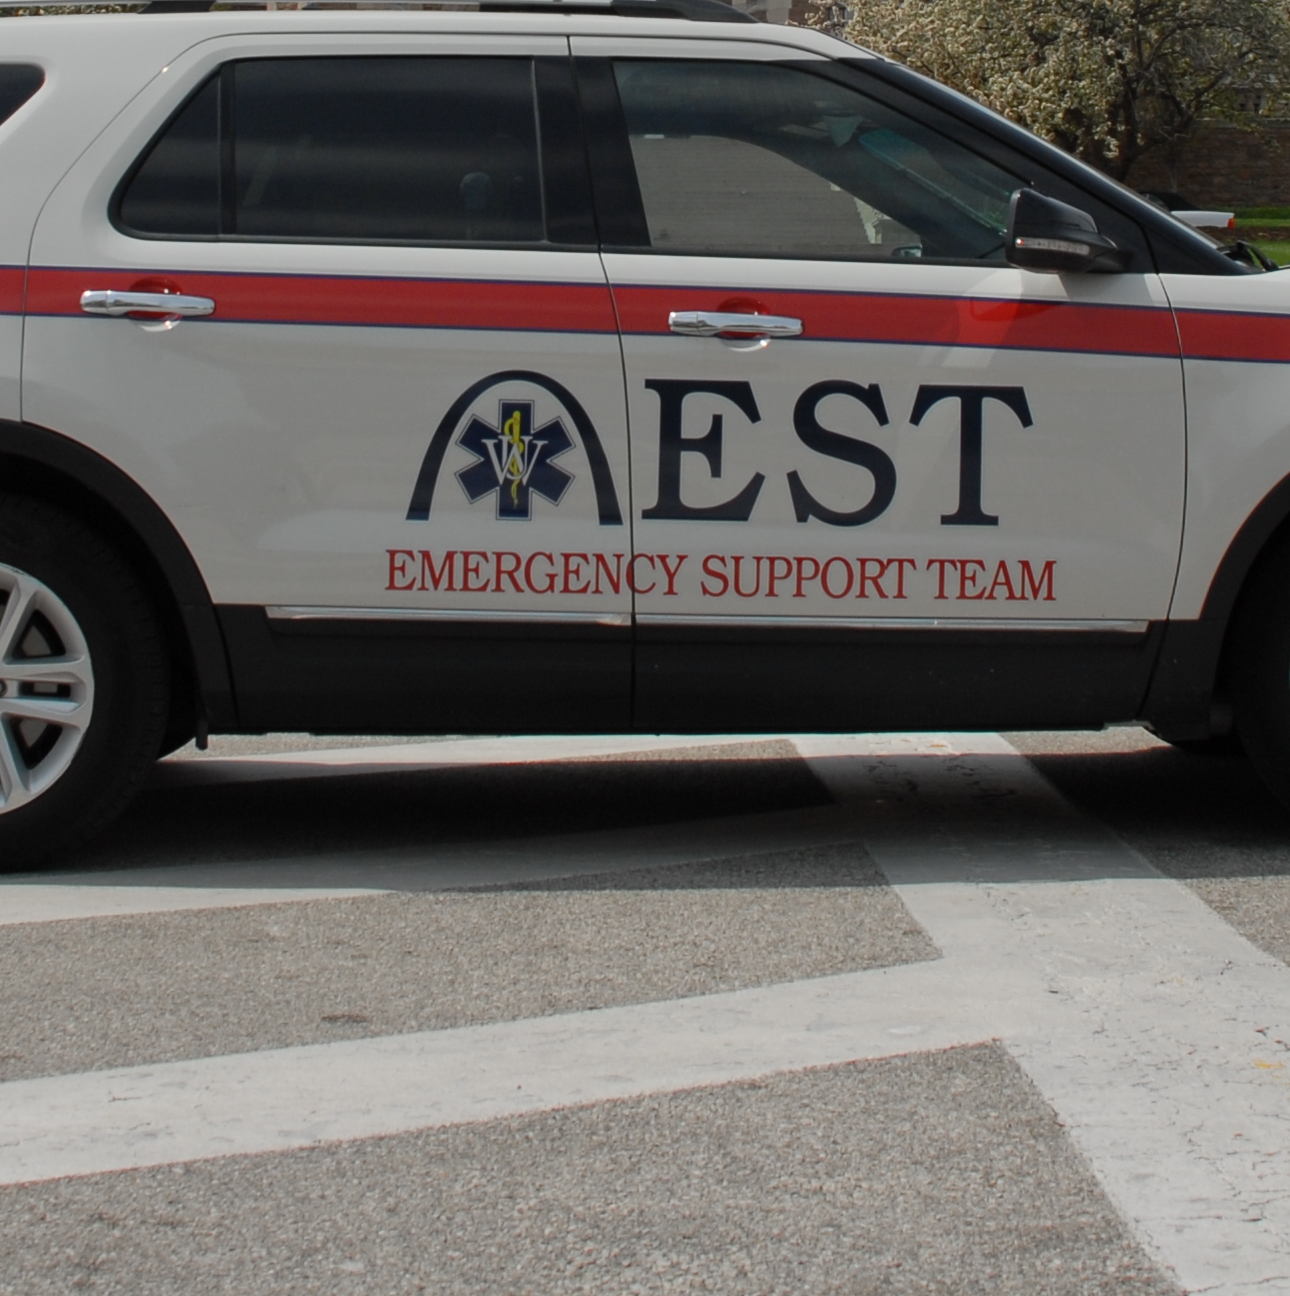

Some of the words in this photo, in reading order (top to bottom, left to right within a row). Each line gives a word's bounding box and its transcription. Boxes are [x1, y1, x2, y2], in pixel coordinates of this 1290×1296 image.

[641, 378, 1034, 527] EST
[384, 548, 689, 596] EMERGENCY
[699, 553, 917, 599] SUPPORT
[926, 557, 1057, 601] TEAM
